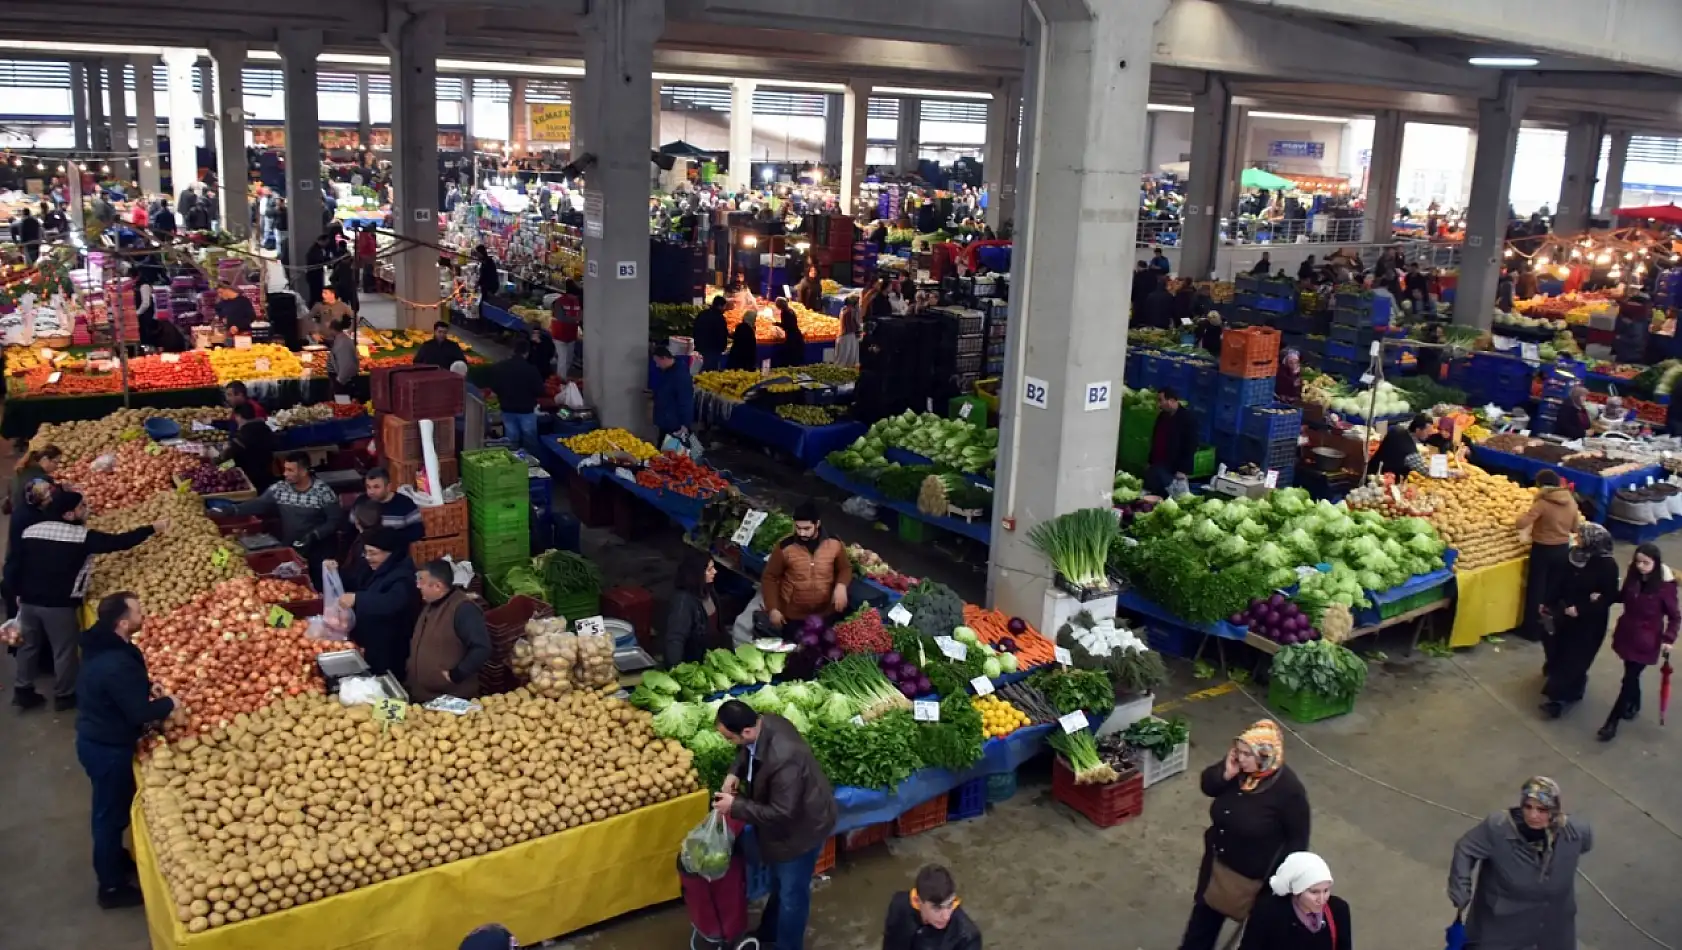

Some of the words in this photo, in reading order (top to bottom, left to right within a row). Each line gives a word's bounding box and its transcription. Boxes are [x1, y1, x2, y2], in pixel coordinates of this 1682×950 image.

[619, 264, 635, 276] B3
[1027, 383, 1045, 404] B2
[1089, 386, 1108, 403] B2
